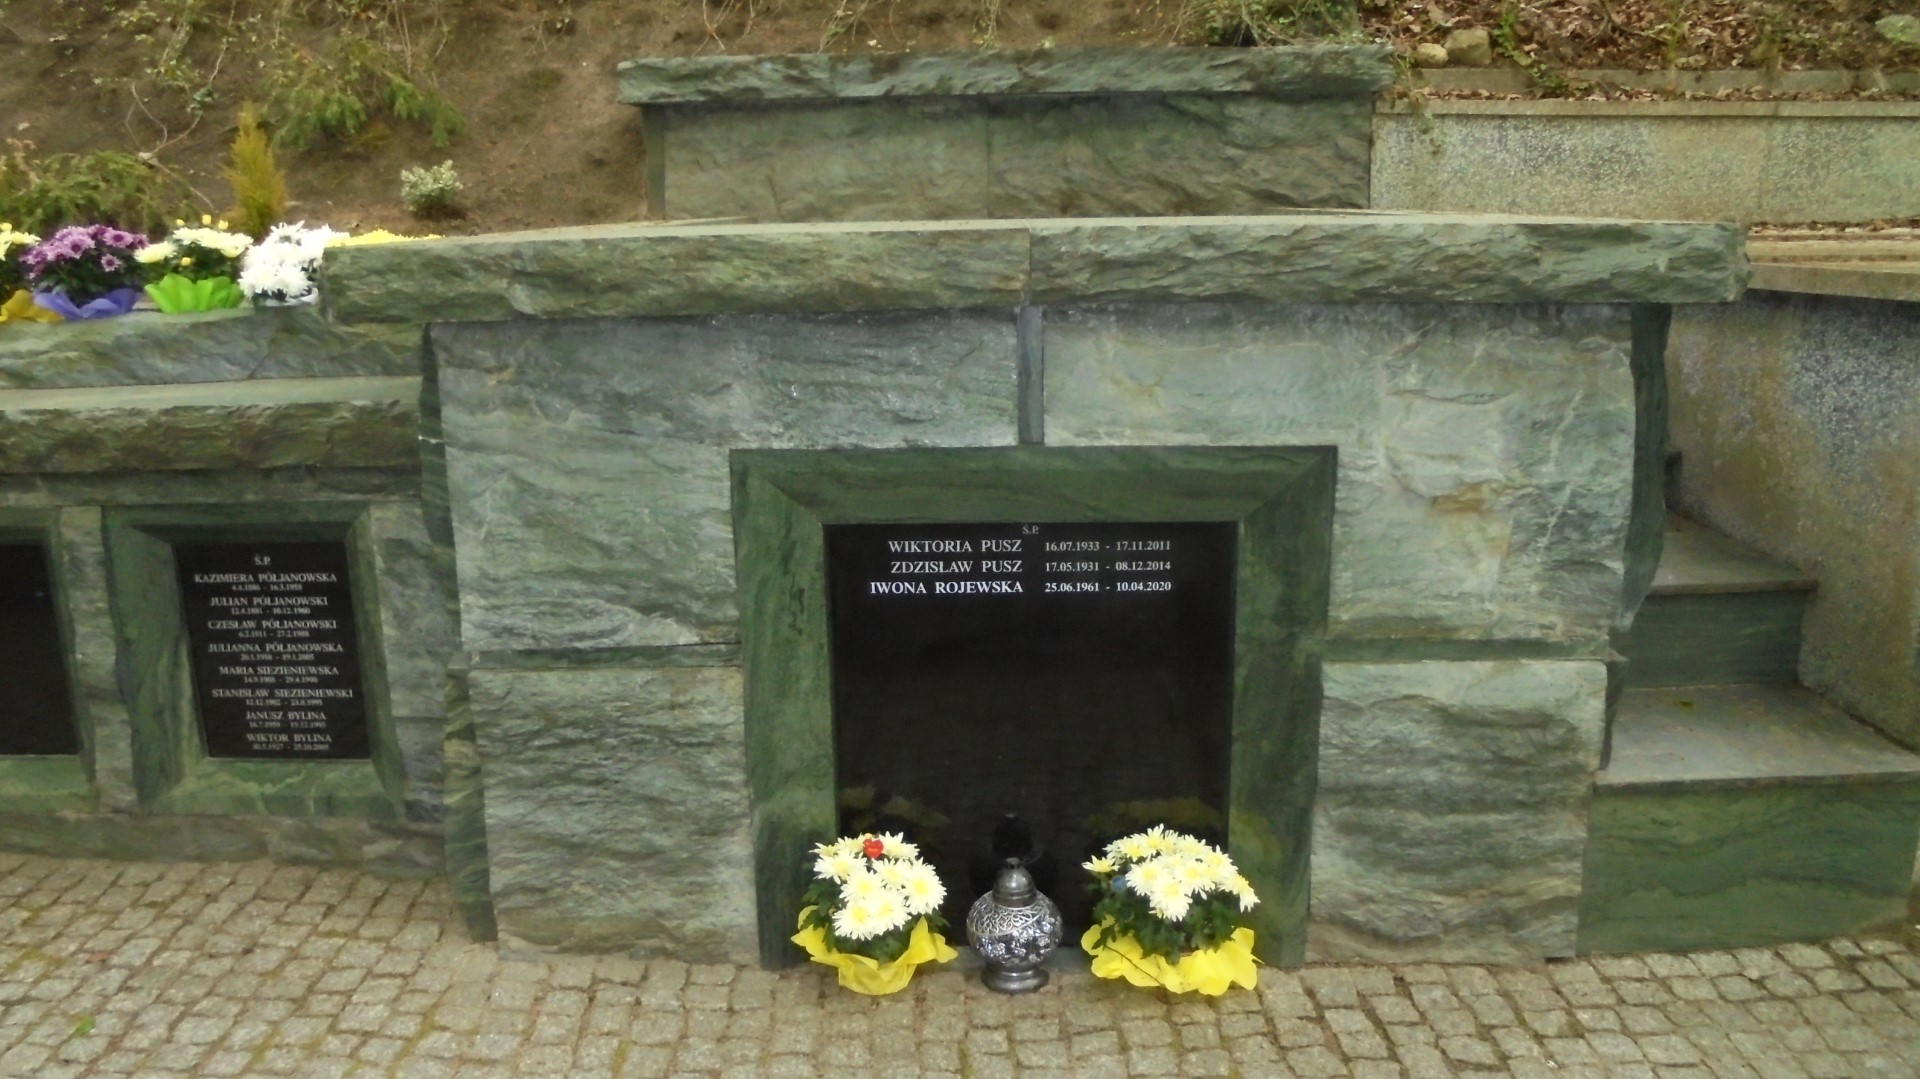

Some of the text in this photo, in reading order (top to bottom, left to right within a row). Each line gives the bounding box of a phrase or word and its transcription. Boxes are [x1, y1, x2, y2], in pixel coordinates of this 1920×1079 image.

[888, 539, 972, 553] WIKTORIA
[981, 539, 1022, 553] PUSZ
[1045, 541, 1100, 552] 16.07.1933
[1116, 540, 1171, 551] 17.11.2011
[890, 560, 974, 574] ZDZISŁAW
[982, 560, 1023, 573] PUSZ
[1045, 561, 1099, 572] 17.05.1931
[1115, 561, 1171, 571] 08.12.2014
[194, 573, 254, 583] KAZIMIERA
[870, 581, 927, 594] IWONA
[935, 580, 1024, 594] ROJEWSKA
[1044, 582, 1100, 593] 25.06.1961
[1116, 581, 1172, 592] 10.04.2020
[210, 596, 249, 606] JULIAN
[208, 619, 257, 629] CZESŁAW
[208, 643, 261, 652] JULIANNA
[219, 666, 254, 675] MARIA
[212, 688, 269, 698] STANISŁAW
[245, 711, 327, 720] JANUSZ BYLINA
[246, 733, 332, 742] WIKTOR BYLINA
